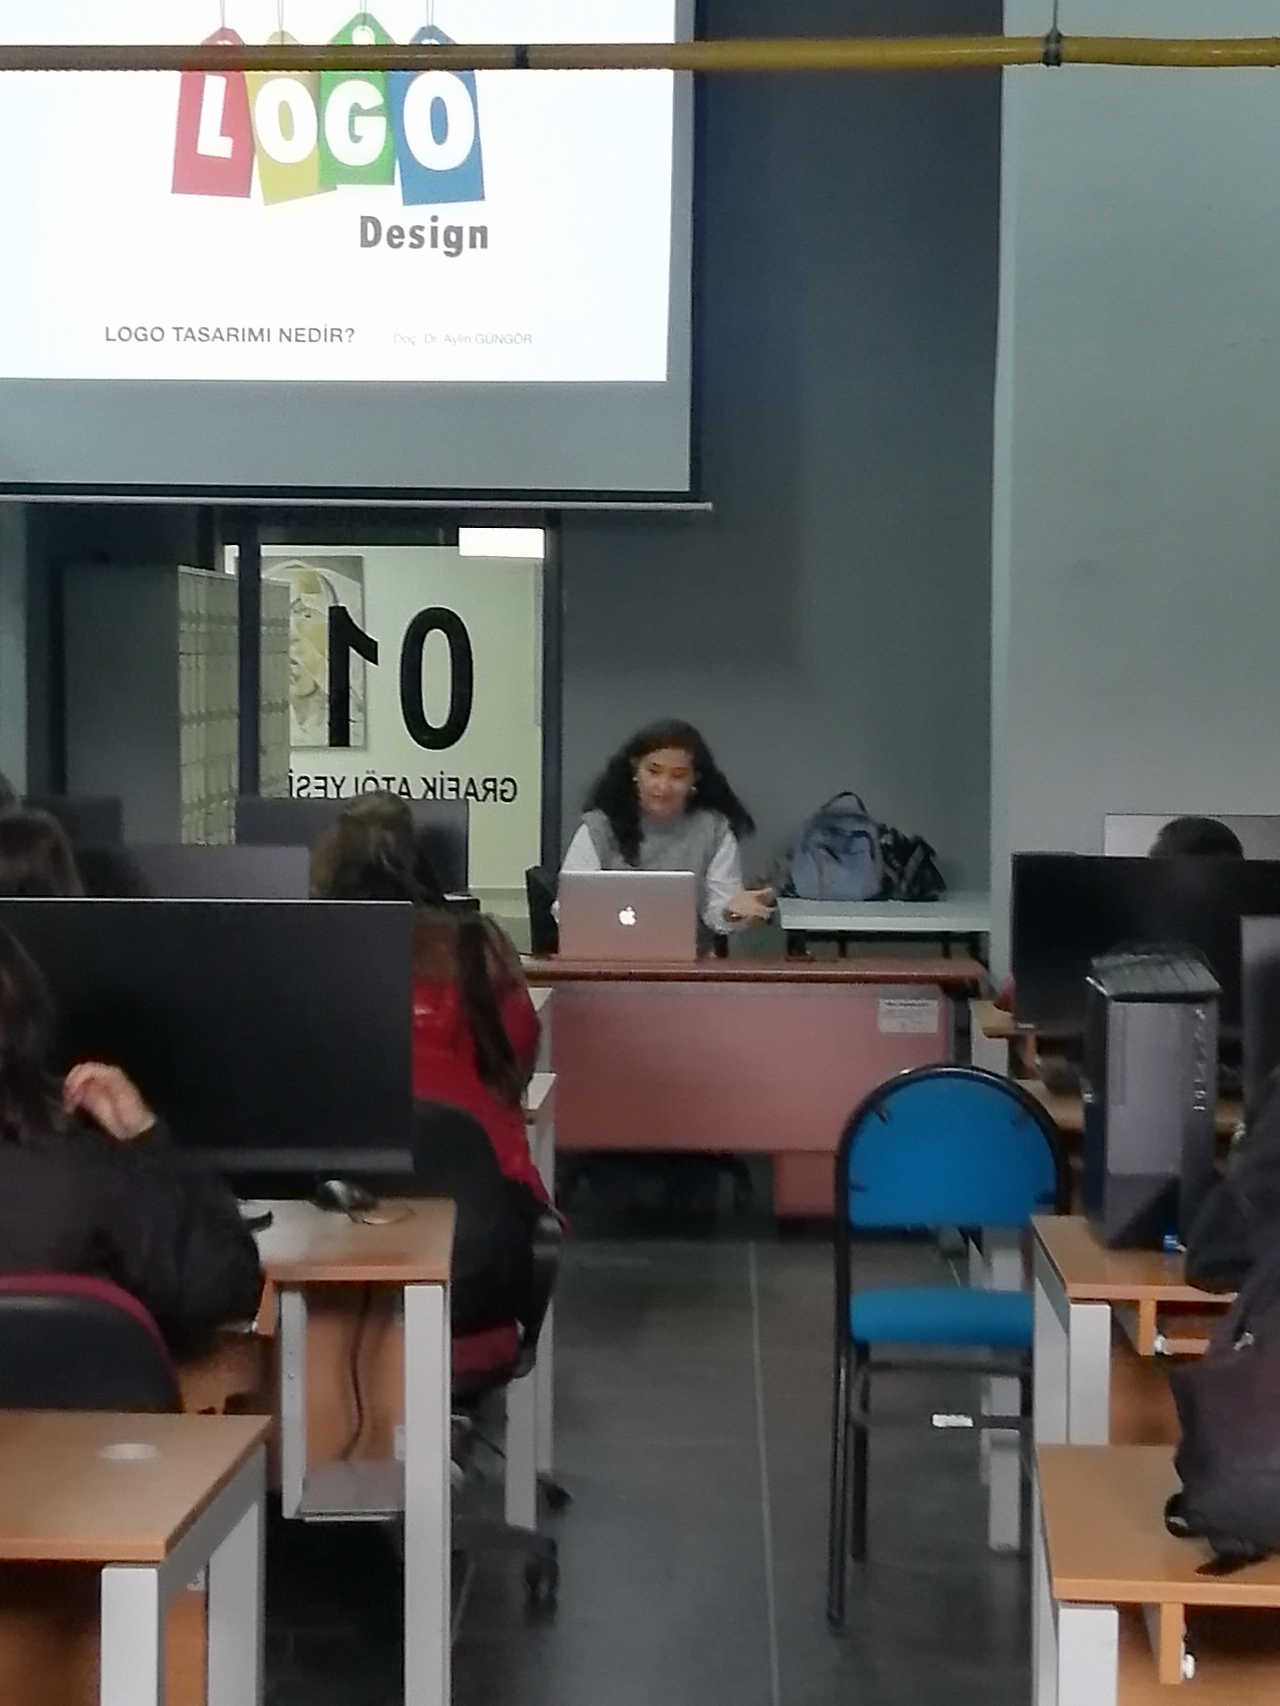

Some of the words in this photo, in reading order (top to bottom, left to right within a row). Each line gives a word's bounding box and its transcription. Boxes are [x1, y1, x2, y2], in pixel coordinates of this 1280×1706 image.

[197, 71, 475, 171] LOGO
[360, 214, 488, 258] Design
[105, 326, 165, 342] LOGO
[172, 326, 271, 343] TASARIMI
[279, 324, 355, 343] NEDİR?
